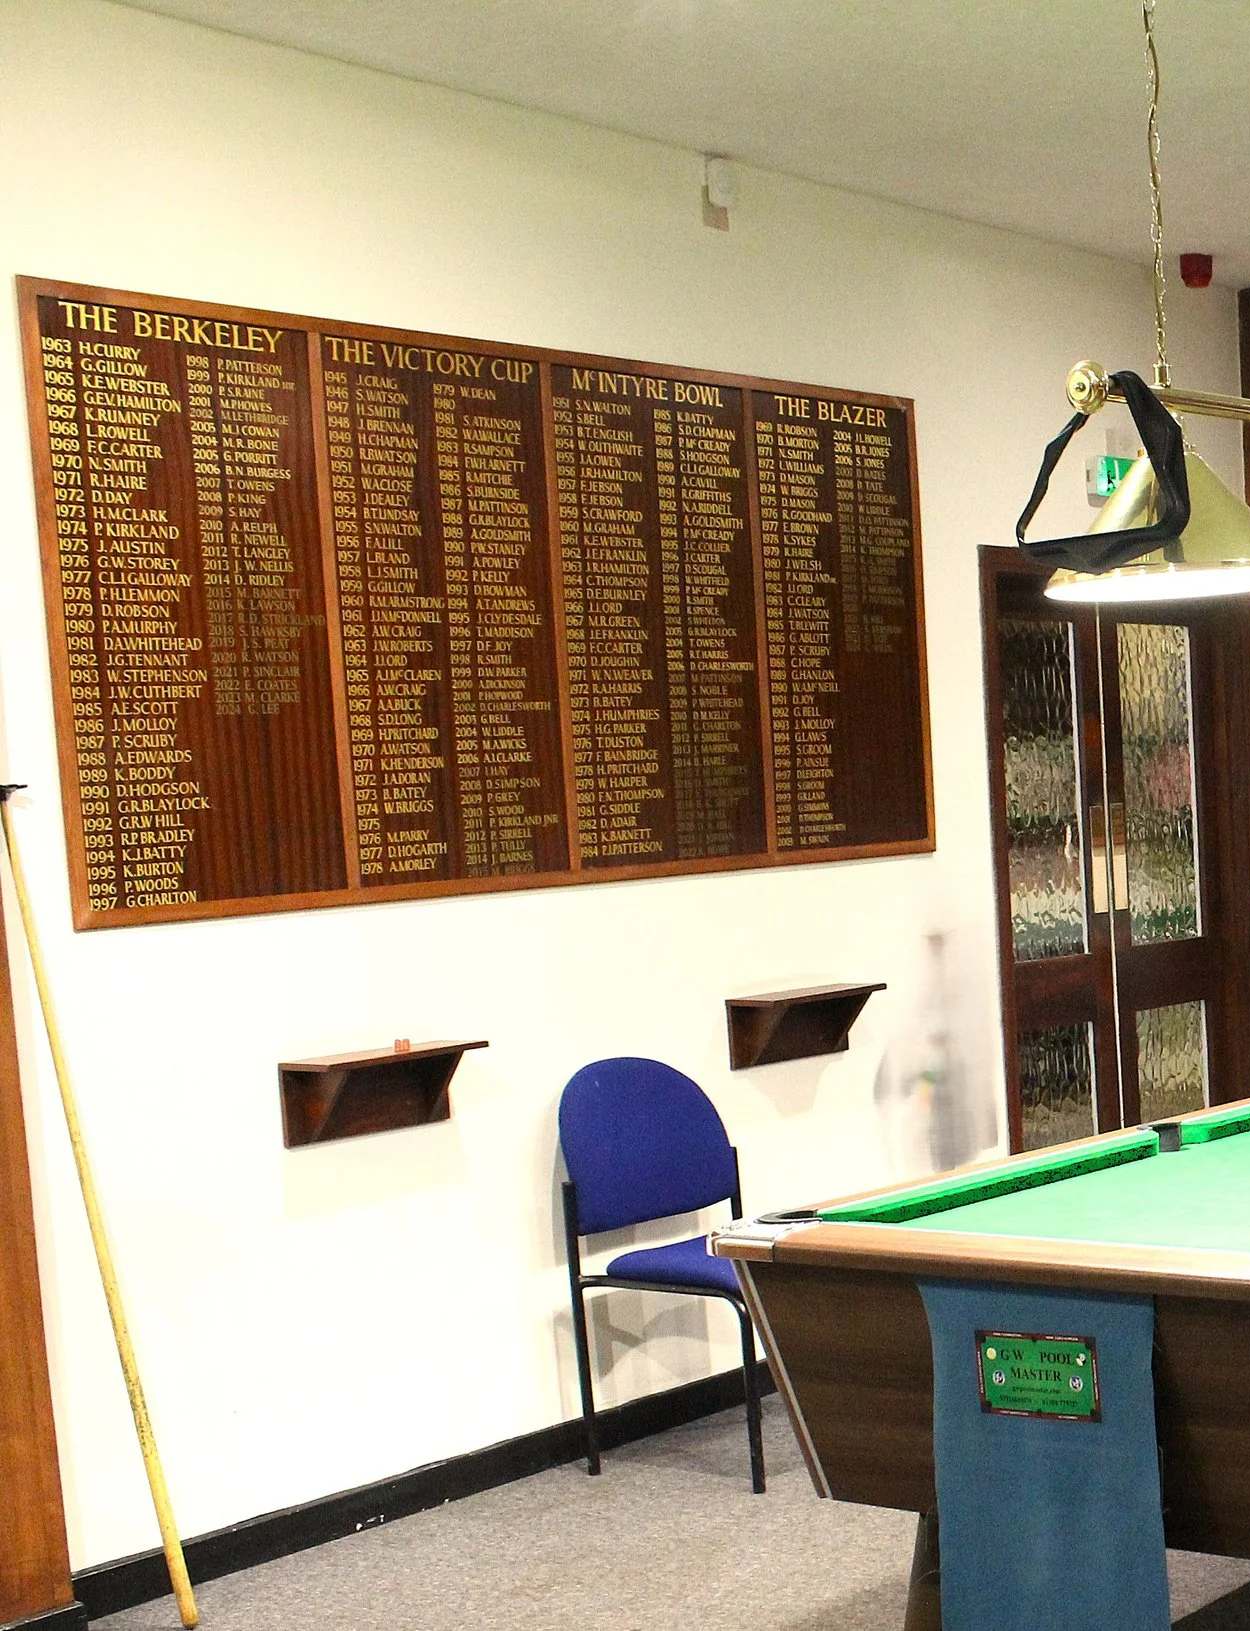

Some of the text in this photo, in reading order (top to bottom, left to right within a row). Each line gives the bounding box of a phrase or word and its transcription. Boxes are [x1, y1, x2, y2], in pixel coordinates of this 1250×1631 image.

[58, 301, 283, 353] THE BERKELEY
[41, 337, 72, 353] 1963
[43, 354, 73, 370] 1964
[186, 355, 209, 368] 1998
[325, 337, 532, 384] THE VICTORY CUP
[44, 370, 74, 386] 1965
[325, 371, 346, 385] 1945
[433, 384, 455, 396] 1979
[675, 382, 723, 407] BOWL
[48, 404, 76, 419] 1967
[774, 396, 887, 428] THE BLAZER
[49, 420, 78, 436] 1968
[50, 437, 80, 452] 1969
[757, 433, 773, 445] 1970
[193, 448, 218, 460] 2005
[758, 446, 772, 457] 1971
[52, 454, 82, 469] 1970
[53, 471, 81, 485] 1971
[759, 471, 775, 481] 1973
[55, 488, 84, 502] 1972
[56, 504, 85, 518] 1973
[560, 507, 578, 518] 1959
[561, 521, 579, 532] 1960
[201, 532, 223, 543] 2011
[245, 534, 287, 546] NEWELL
[202, 546, 227, 557] 2012
[244, 547, 290, 559] LANGLEY
[61, 555, 89, 568] 1976
[204, 574, 230, 584] 2014
[249, 575, 285, 586] RIDLEY
[563, 575, 582, 585] 1964
[65, 603, 93, 616] 1979
[568, 642, 586, 654] 1969
[69, 654, 98, 666] 1982
[70, 670, 99, 683] 1983
[72, 686, 100, 699] 1984
[571, 684, 589, 694] 1972
[73, 702, 102, 715] 1985
[350, 714, 371, 726] 1968
[78, 753, 106, 766] 1988
[81, 786, 109, 799] 1990
[82, 802, 109, 815] 1991
[360, 847, 382, 860] 1977
[88, 867, 116, 880] 1995
[361, 862, 383, 874] 1978
[90, 898, 117, 911] 1997
[1012, 1350, 1024, 1360] W
[1040, 1352, 1074, 1365] POOL
[1010, 1367, 1062, 1381] MASTER
